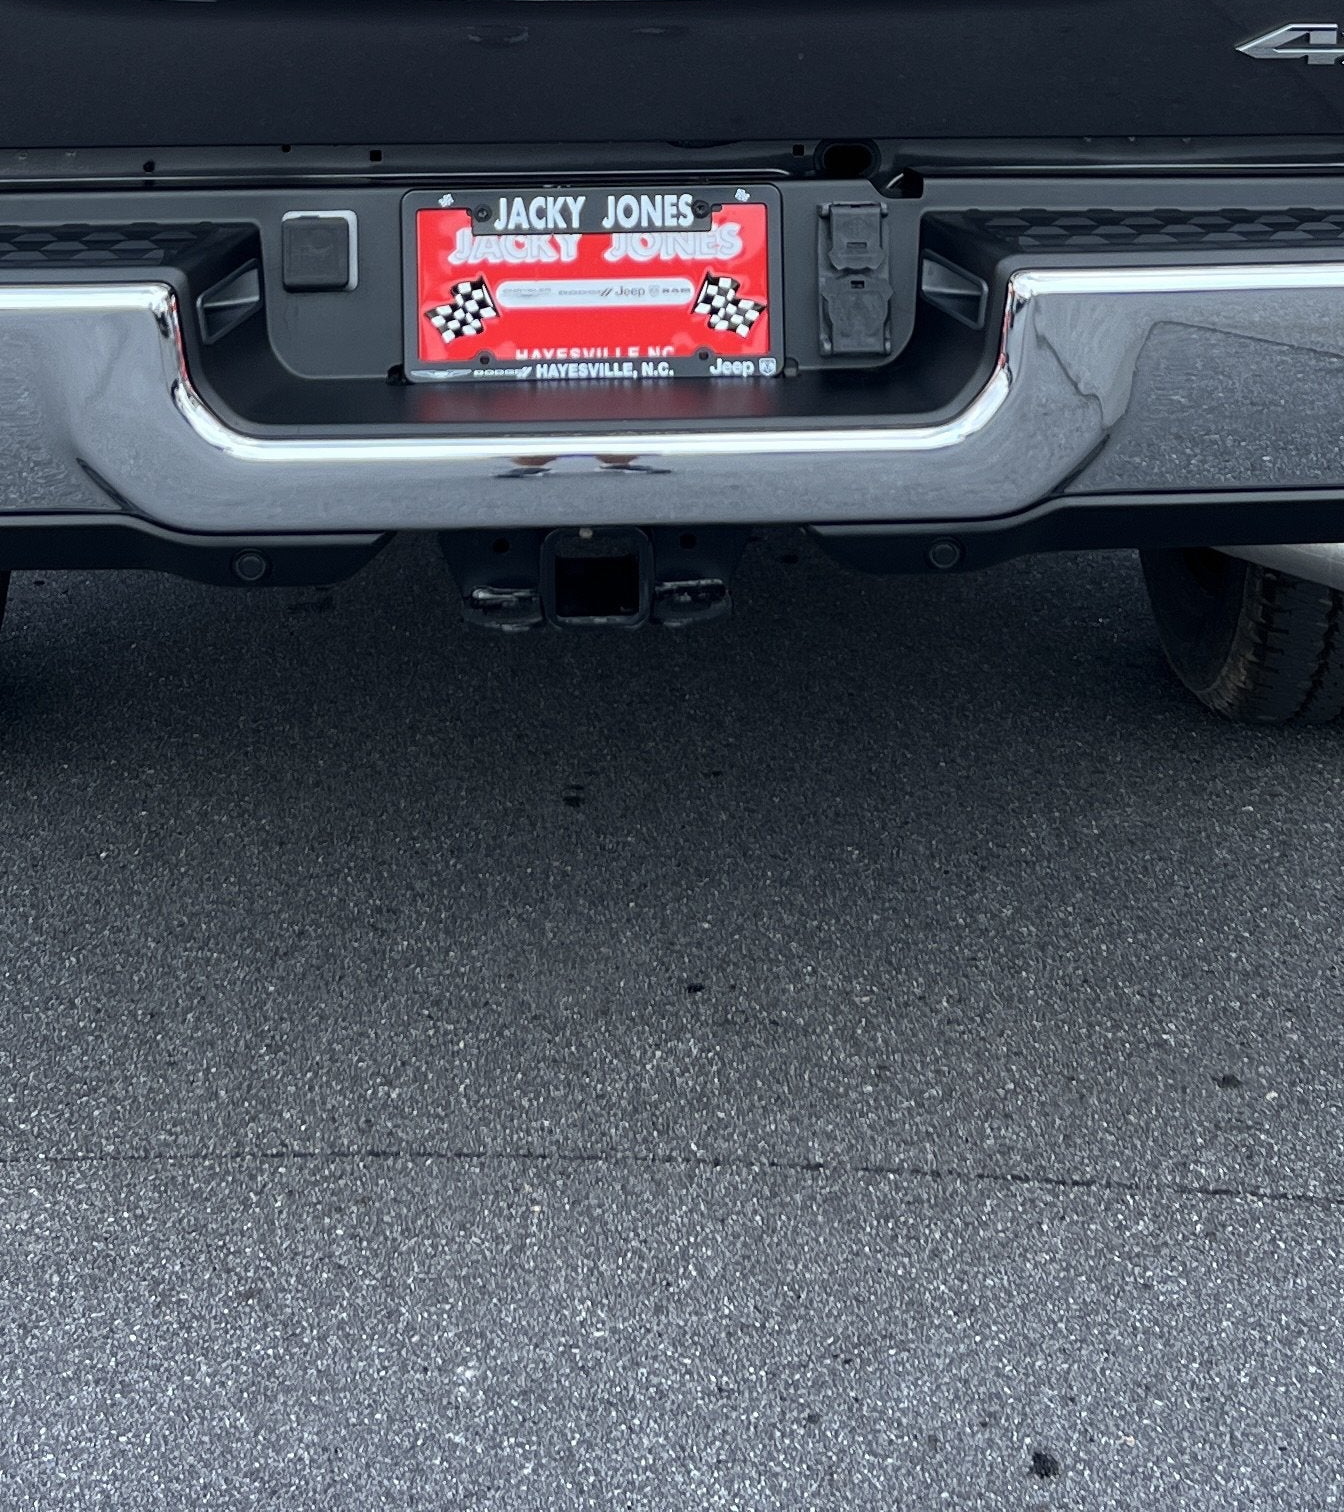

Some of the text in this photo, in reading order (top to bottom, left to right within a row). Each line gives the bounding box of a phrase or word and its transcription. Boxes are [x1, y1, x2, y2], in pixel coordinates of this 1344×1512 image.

[493, 193, 695, 231] JACKY JONES
[447, 221, 743, 265] JACKY JONES
[615, 285, 646, 298] Jeep
[535, 361, 638, 380] HAYESVILLE,
[641, 361, 675, 378] N.C.
[709, 357, 755, 378] Jeep
